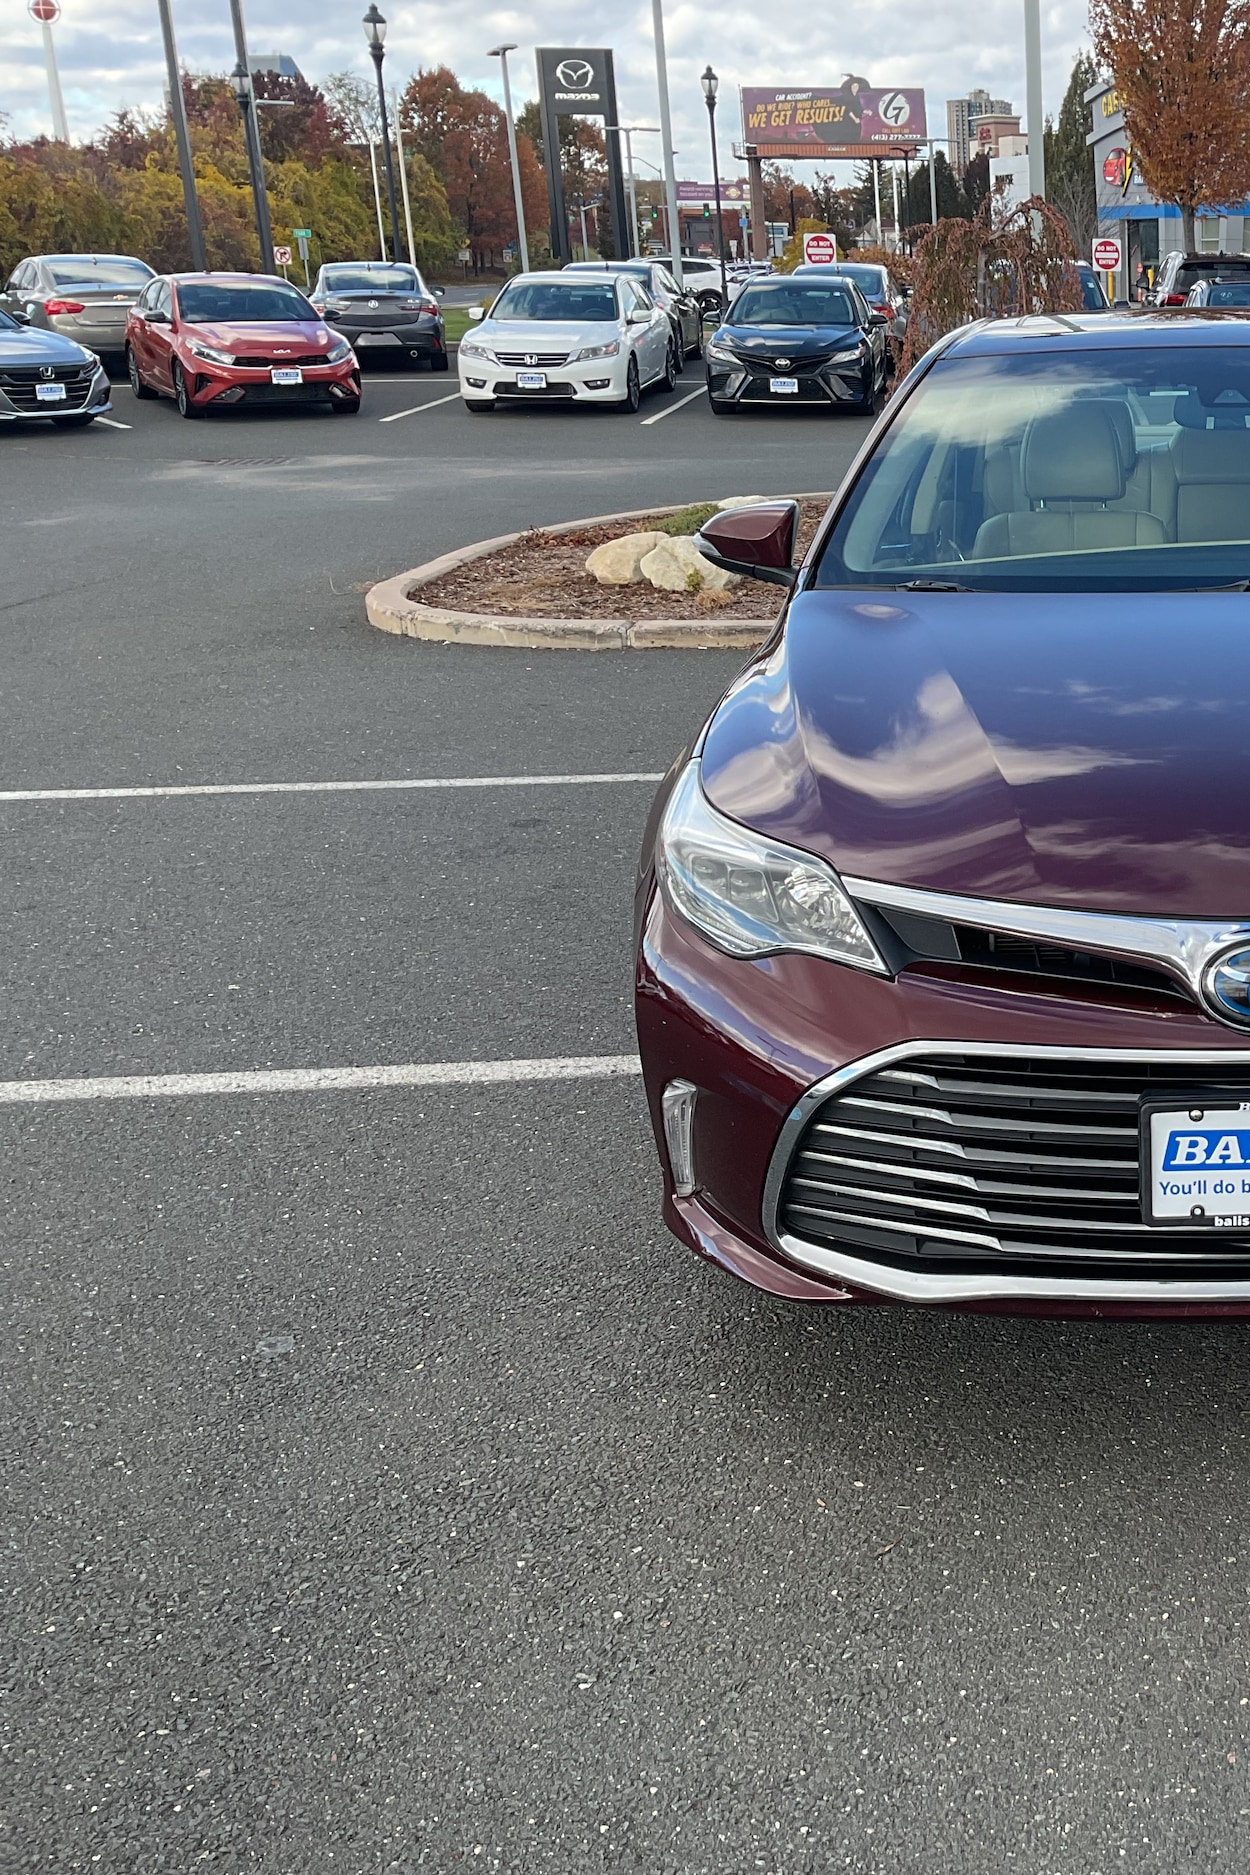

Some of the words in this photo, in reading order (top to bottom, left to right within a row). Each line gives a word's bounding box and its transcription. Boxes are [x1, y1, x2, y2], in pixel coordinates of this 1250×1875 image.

[786, 92, 812, 101] ACCIDENT?
[756, 104, 765, 112] DO
[767, 103, 777, 112] WE
[778, 101, 795, 111] RIDE?
[796, 100, 811, 109] WHO
[749, 112, 767, 128] WE
[770, 110, 792, 126] GET
[795, 105, 846, 124] RESULTS!
[1213, 1180, 1235, 1194] do
